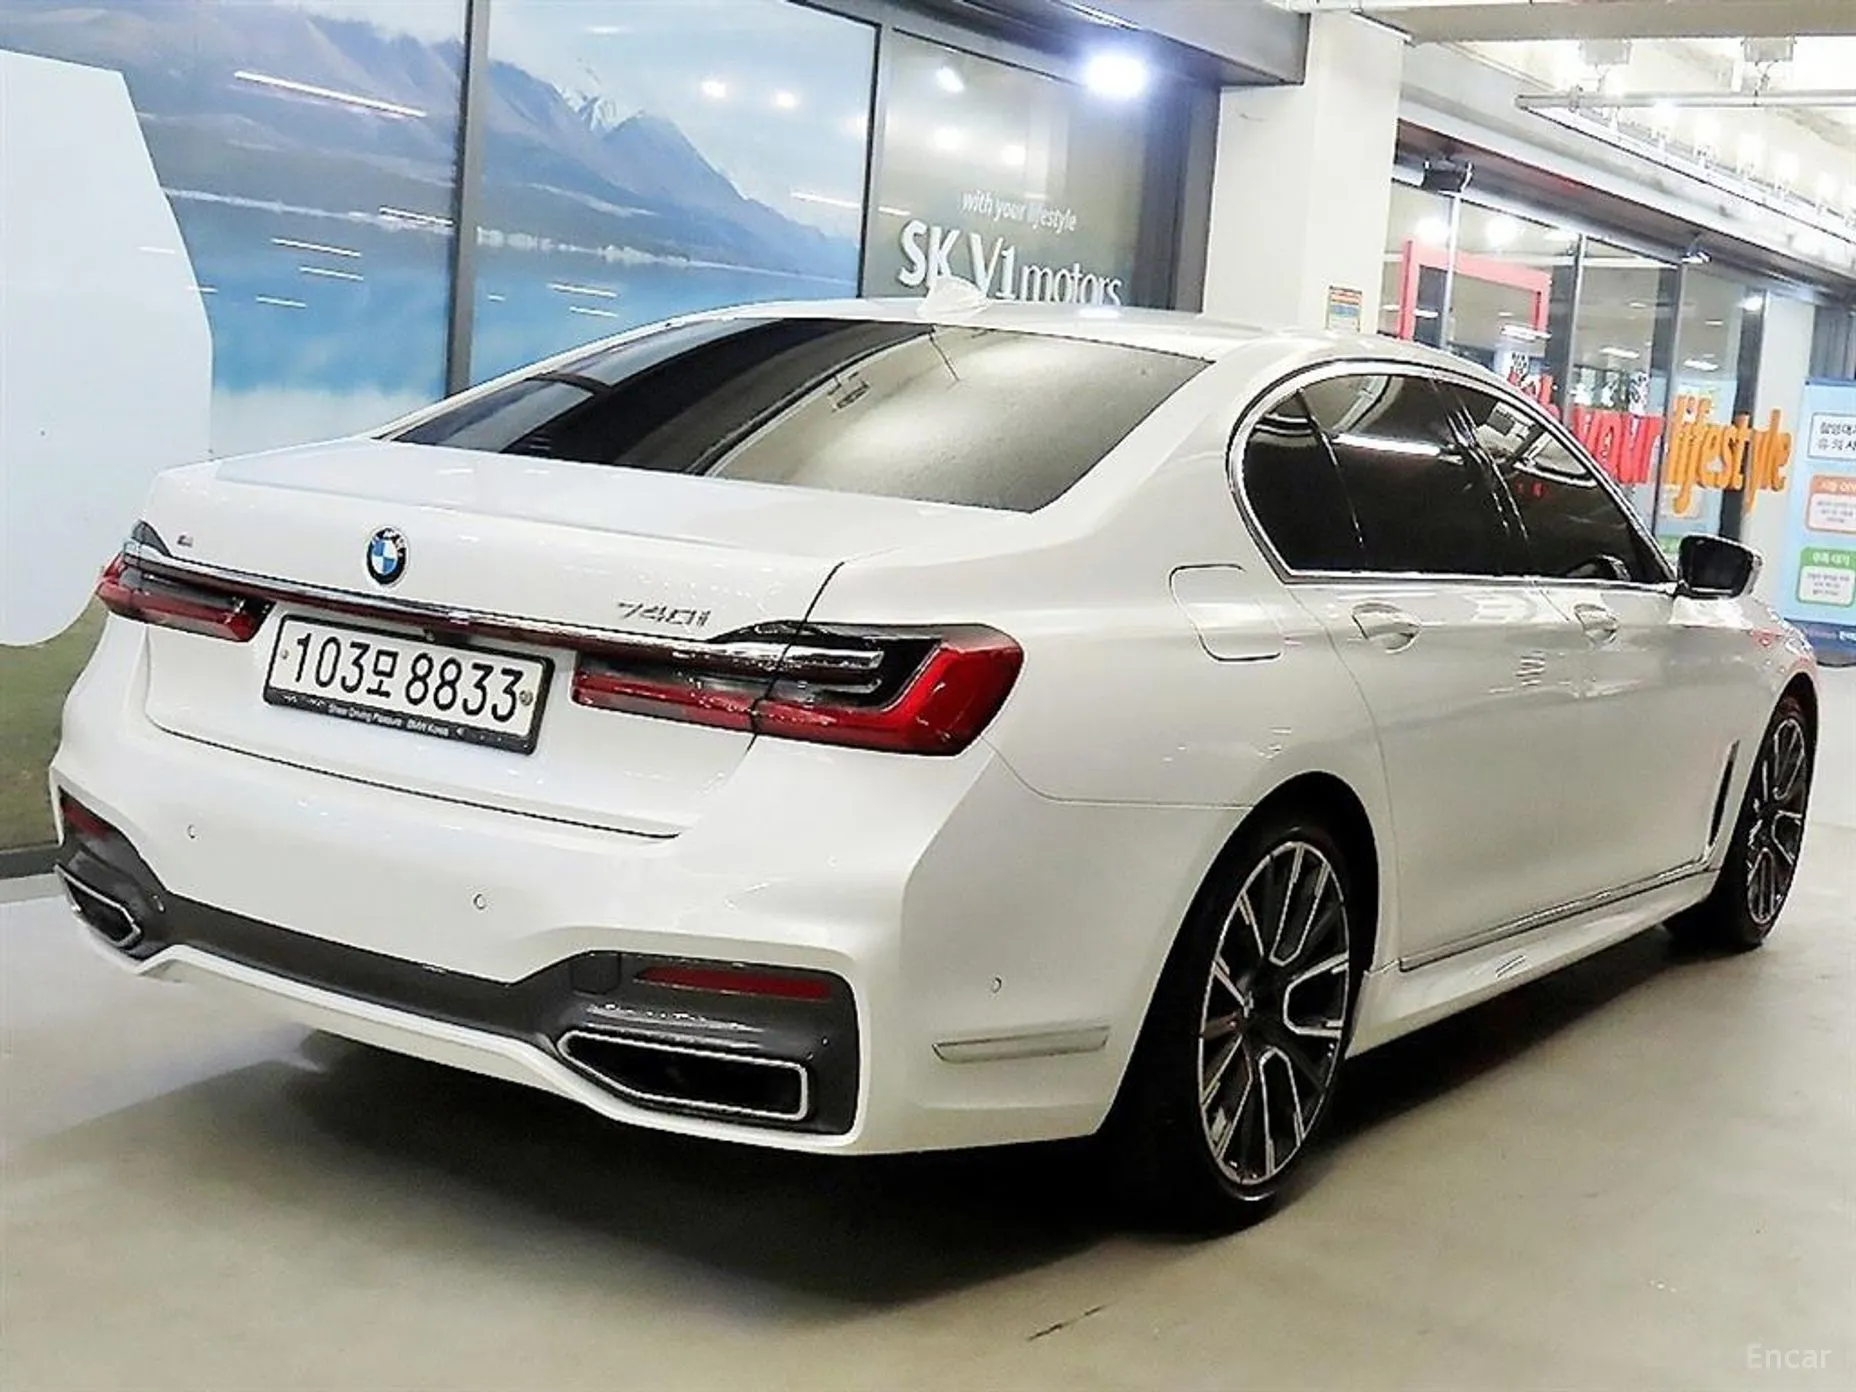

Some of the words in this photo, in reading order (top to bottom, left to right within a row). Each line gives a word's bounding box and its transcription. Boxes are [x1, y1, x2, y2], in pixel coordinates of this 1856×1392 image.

[960, 189, 993, 215] with
[993, 199, 1026, 222] your
[899, 219, 962, 287] SK
[1668, 393, 1792, 514] lifestyle
[617, 602, 712, 627] 740i
